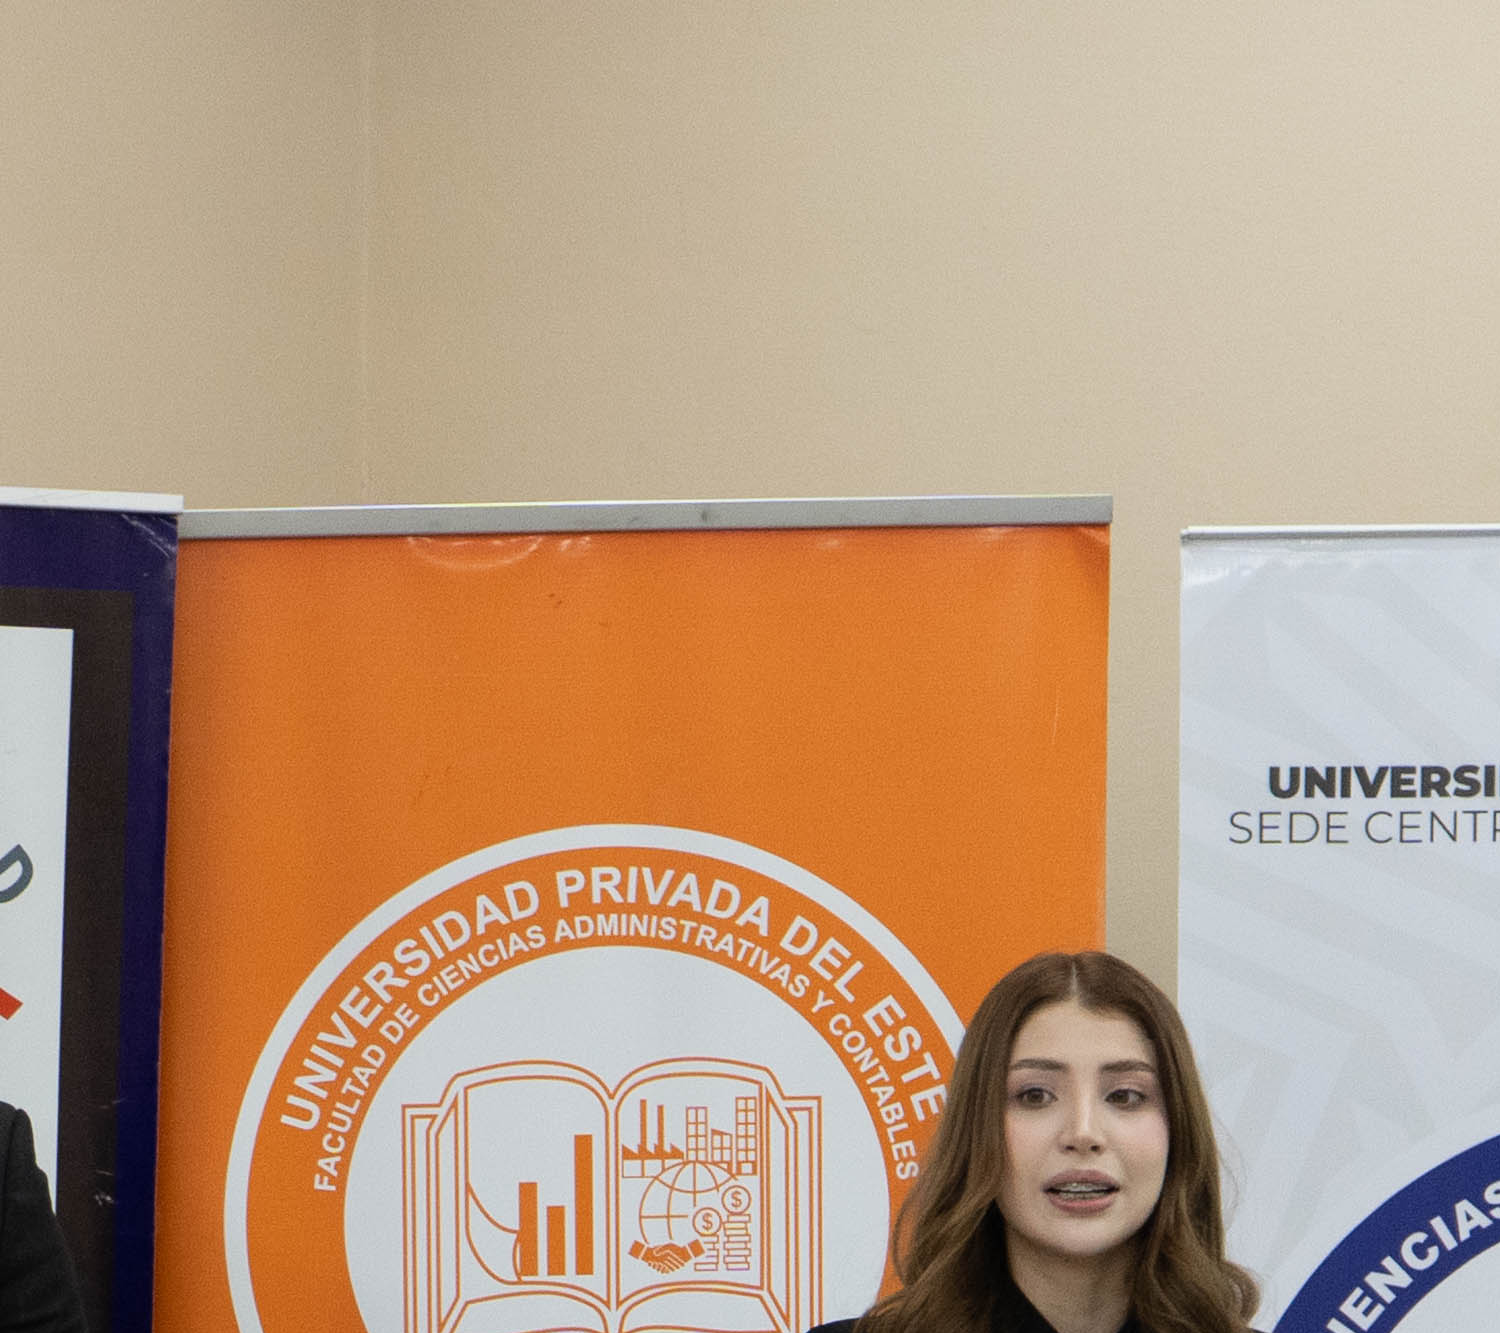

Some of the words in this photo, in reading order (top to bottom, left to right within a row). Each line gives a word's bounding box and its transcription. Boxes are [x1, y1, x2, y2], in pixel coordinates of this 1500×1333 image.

[1229, 811, 1348, 844] SEDE
[280, 879, 541, 1134] UNIVERSIDAD
[556, 867, 770, 938] PRIVADA
[784, 917, 864, 1003] DEL
[866, 996, 948, 1122] ESTE
[311, 1045, 386, 1190] FACULTAD
[380, 1004, 419, 1044] DE
[418, 926, 546, 1006] CIENCIAS
[555, 914, 812, 1000] ADMINISTRATIVAS
[812, 991, 834, 1012] Y
[828, 1015, 921, 1182] CONTABLES
